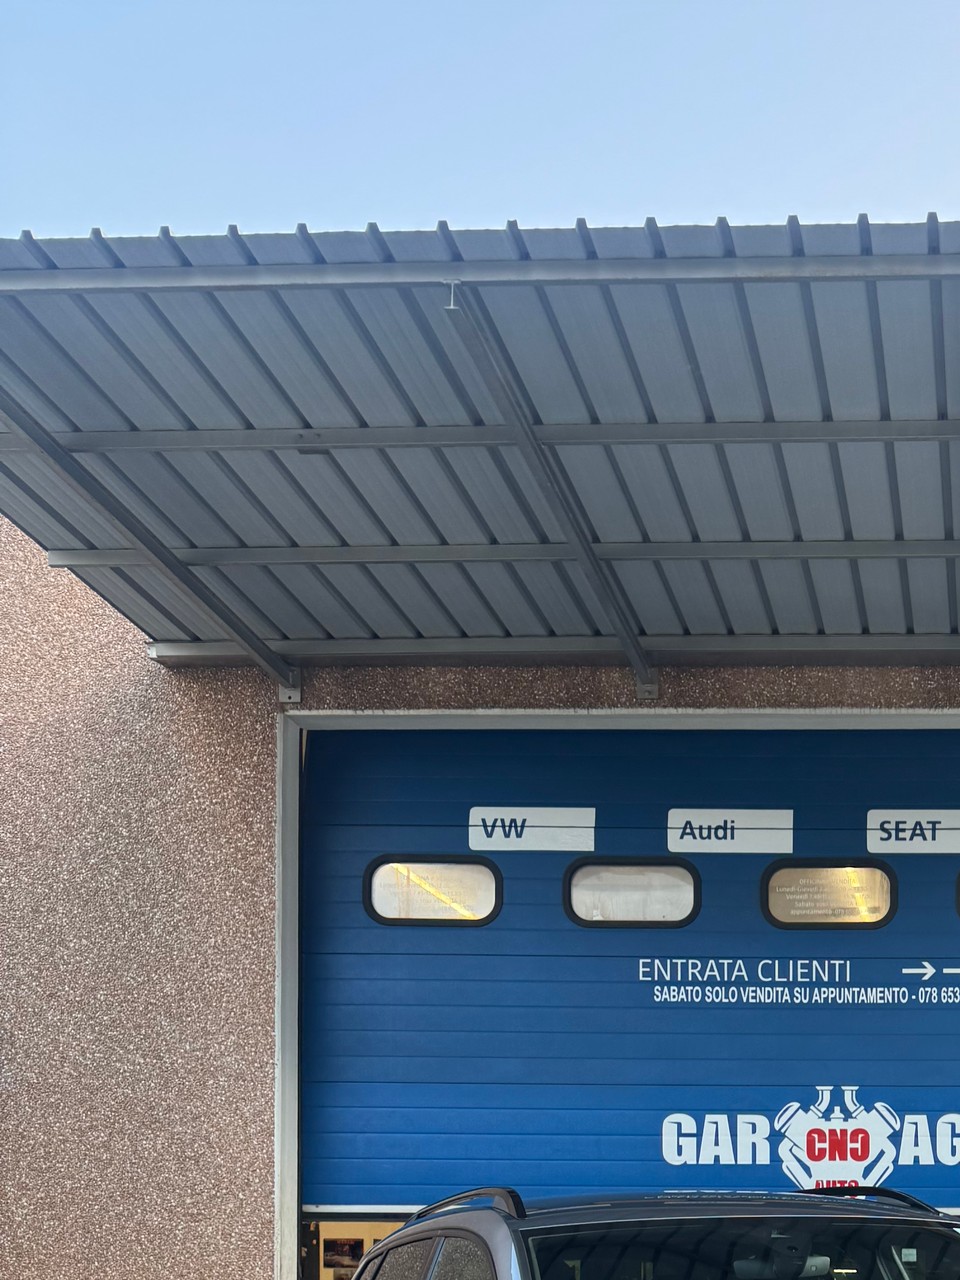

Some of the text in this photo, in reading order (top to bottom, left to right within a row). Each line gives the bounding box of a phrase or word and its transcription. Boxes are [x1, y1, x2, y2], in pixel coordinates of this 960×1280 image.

[481, 817, 527, 839] VW
[679, 819, 735, 841] Audi
[879, 820, 941, 842] SEAT
[638, 958, 851, 982] ENTRATA CLIENTI
[653, 985, 702, 1003] SABATO
[704, 986, 738, 1003] SOLO
[740, 986, 791, 1003] VENDITA
[793, 987, 809, 1004] SU
[812, 987, 908, 1004] APPUNTAMENTO
[918, 987, 938, 1003] 078
[940, 987, 960, 1003] 653
